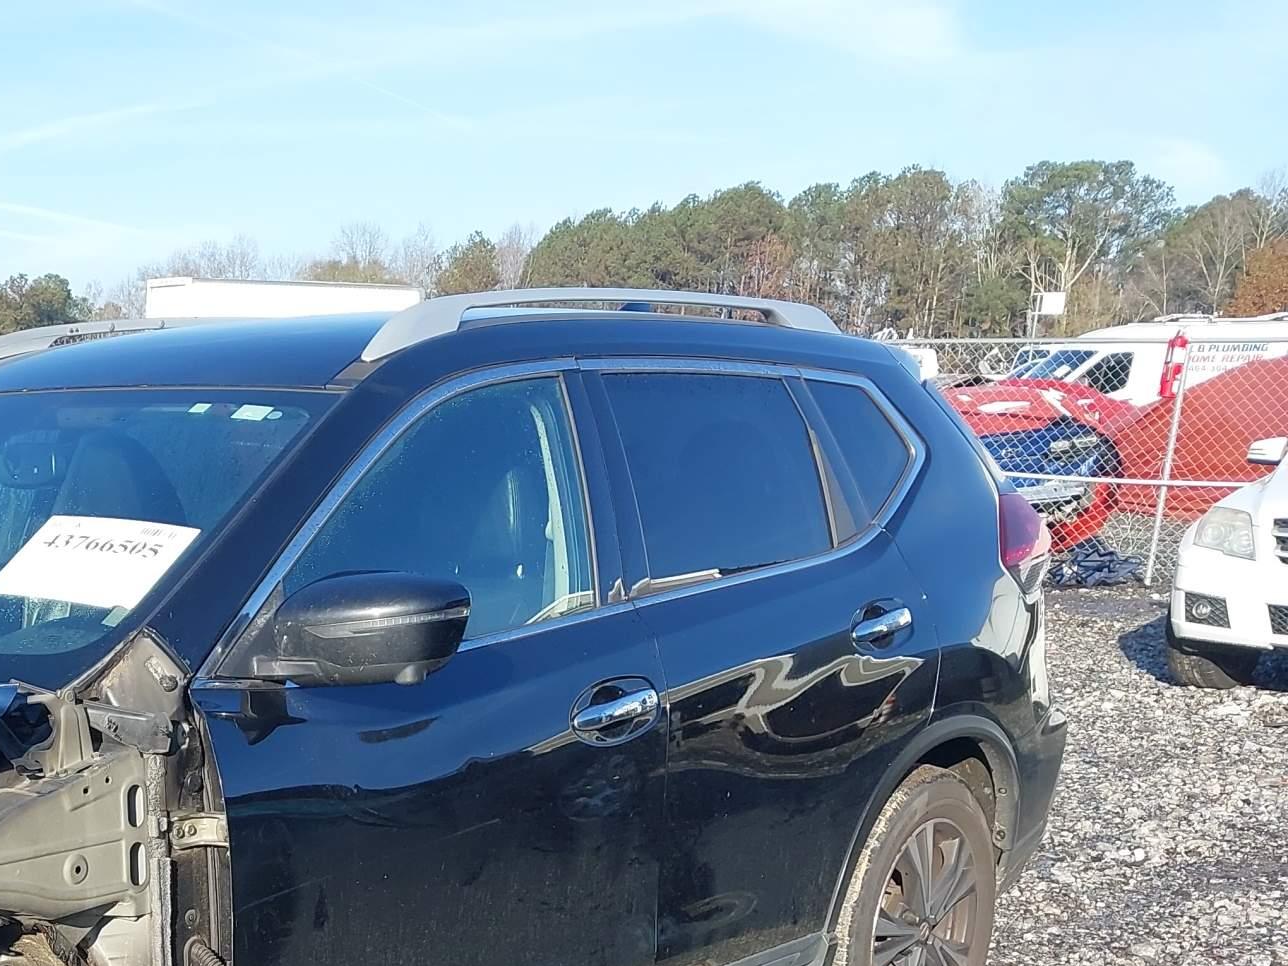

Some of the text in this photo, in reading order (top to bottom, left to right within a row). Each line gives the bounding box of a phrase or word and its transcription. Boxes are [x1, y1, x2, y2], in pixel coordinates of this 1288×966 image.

[1208, 343, 1268, 352] PLUMBING
[1221, 353, 1264, 363] REPAIR
[43, 534, 164, 558] 43766505
